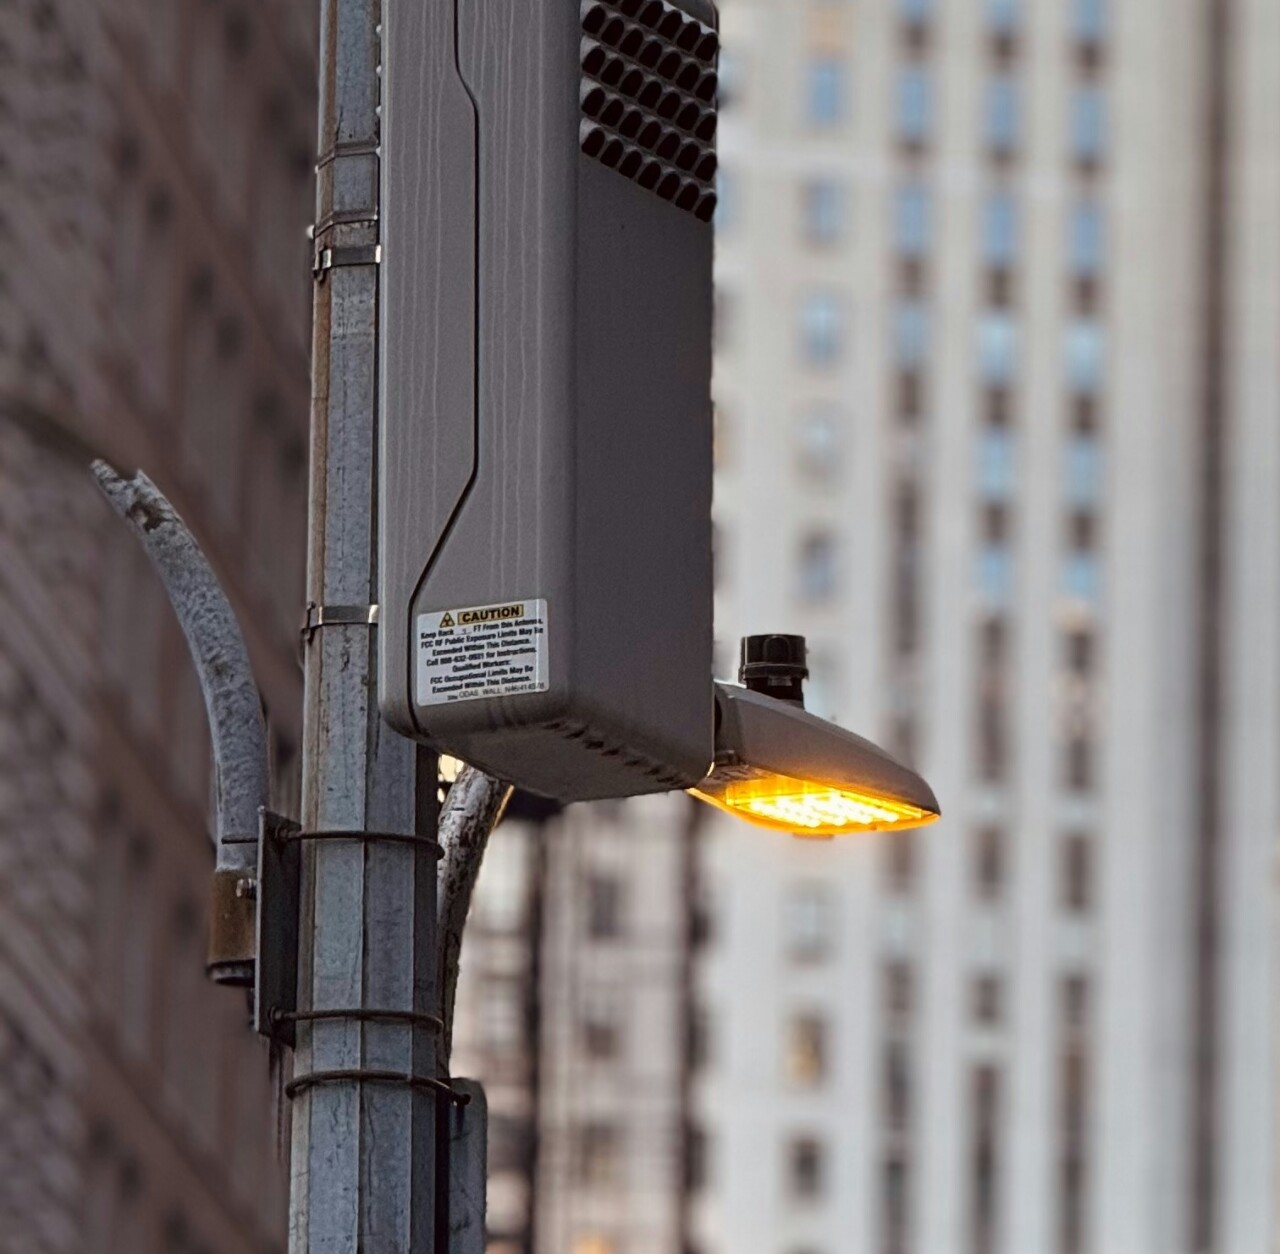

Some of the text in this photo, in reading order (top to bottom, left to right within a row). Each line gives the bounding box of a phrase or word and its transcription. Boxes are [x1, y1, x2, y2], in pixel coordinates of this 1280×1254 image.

[462, 605, 520, 623] CAUTION
[421, 632, 437, 640] Keep
[438, 629, 454, 637] Back
[473, 624, 482, 632] FT
[482, 623, 500, 631] From
[421, 640, 434, 648] FCC
[435, 639, 443, 647] RF
[444, 637, 465, 646] Public
[466, 633, 497, 643] Exposure
[497, 630, 518, 638] Limits
[519, 627, 533, 636] May
[432, 638, 531, 657] Exceeded Within This Distance.
[426, 657, 439, 667] Call
[486, 651, 496, 659] for
[452, 662, 482, 673] Qualified
[430, 664, 534, 685] FCC Occupational Limits May Be
[432, 676, 531, 694] Exceeded Within This Distance.
